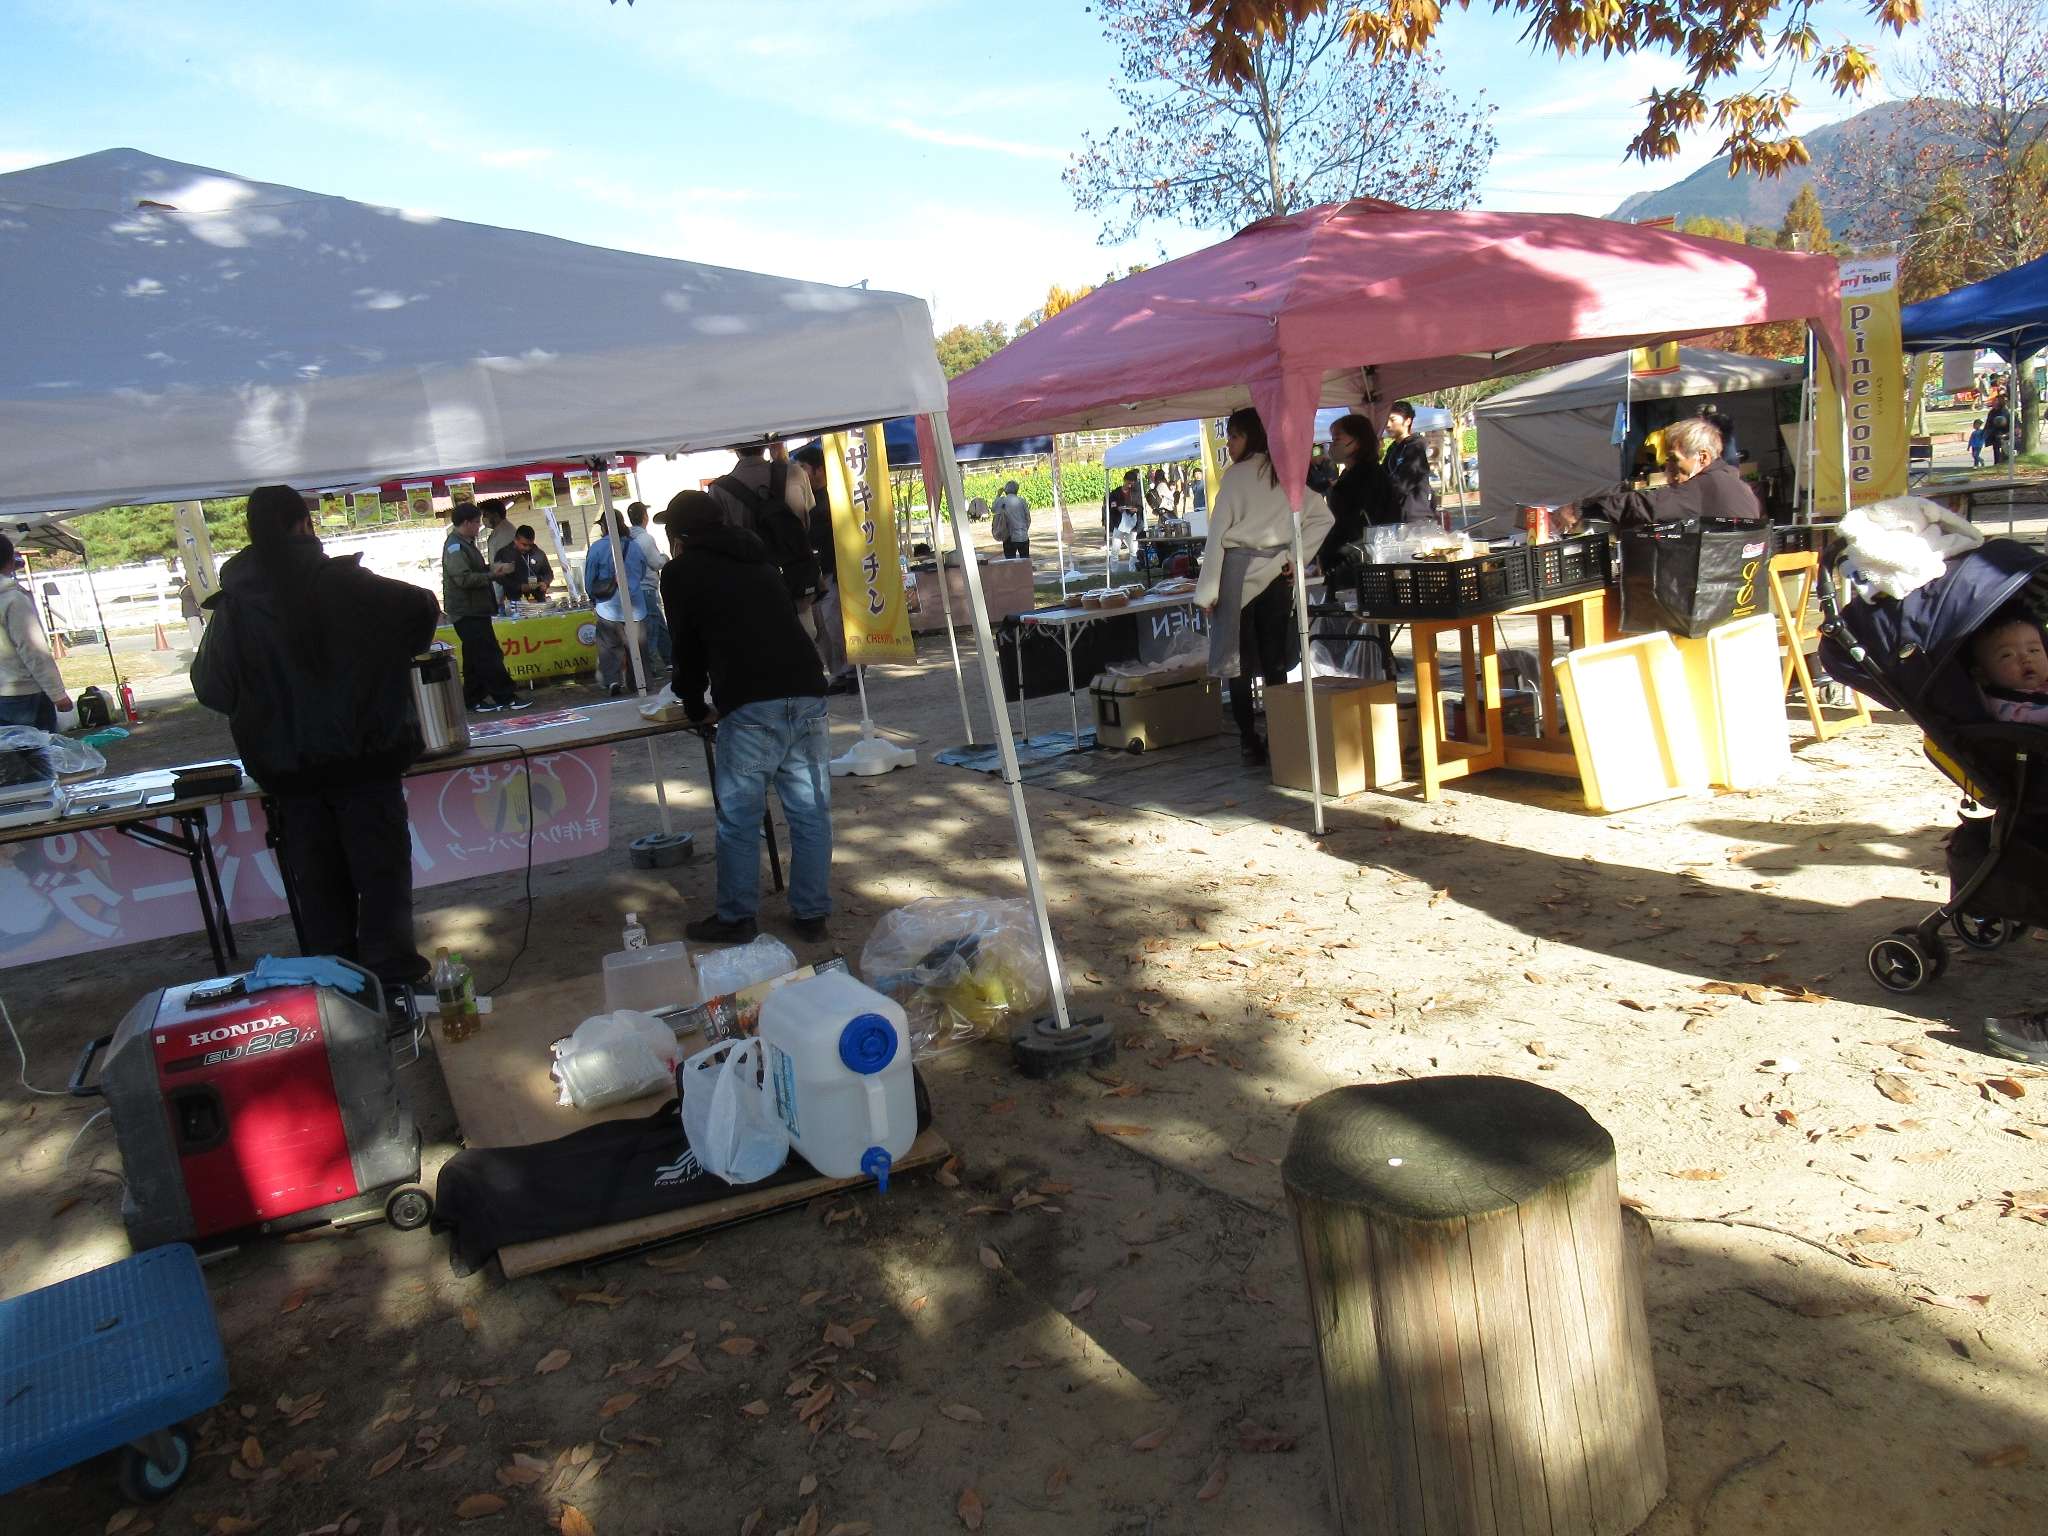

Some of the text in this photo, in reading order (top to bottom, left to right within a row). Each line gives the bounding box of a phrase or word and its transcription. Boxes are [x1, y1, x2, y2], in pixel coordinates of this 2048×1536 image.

[1863, 271, 1892, 284] holic
[1850, 305, 1873, 482] Pinecone
[497, 635, 562, 657] カレー
[507, 656, 590, 677] URRY NAAN
[187, 1014, 290, 1047] HONDA
